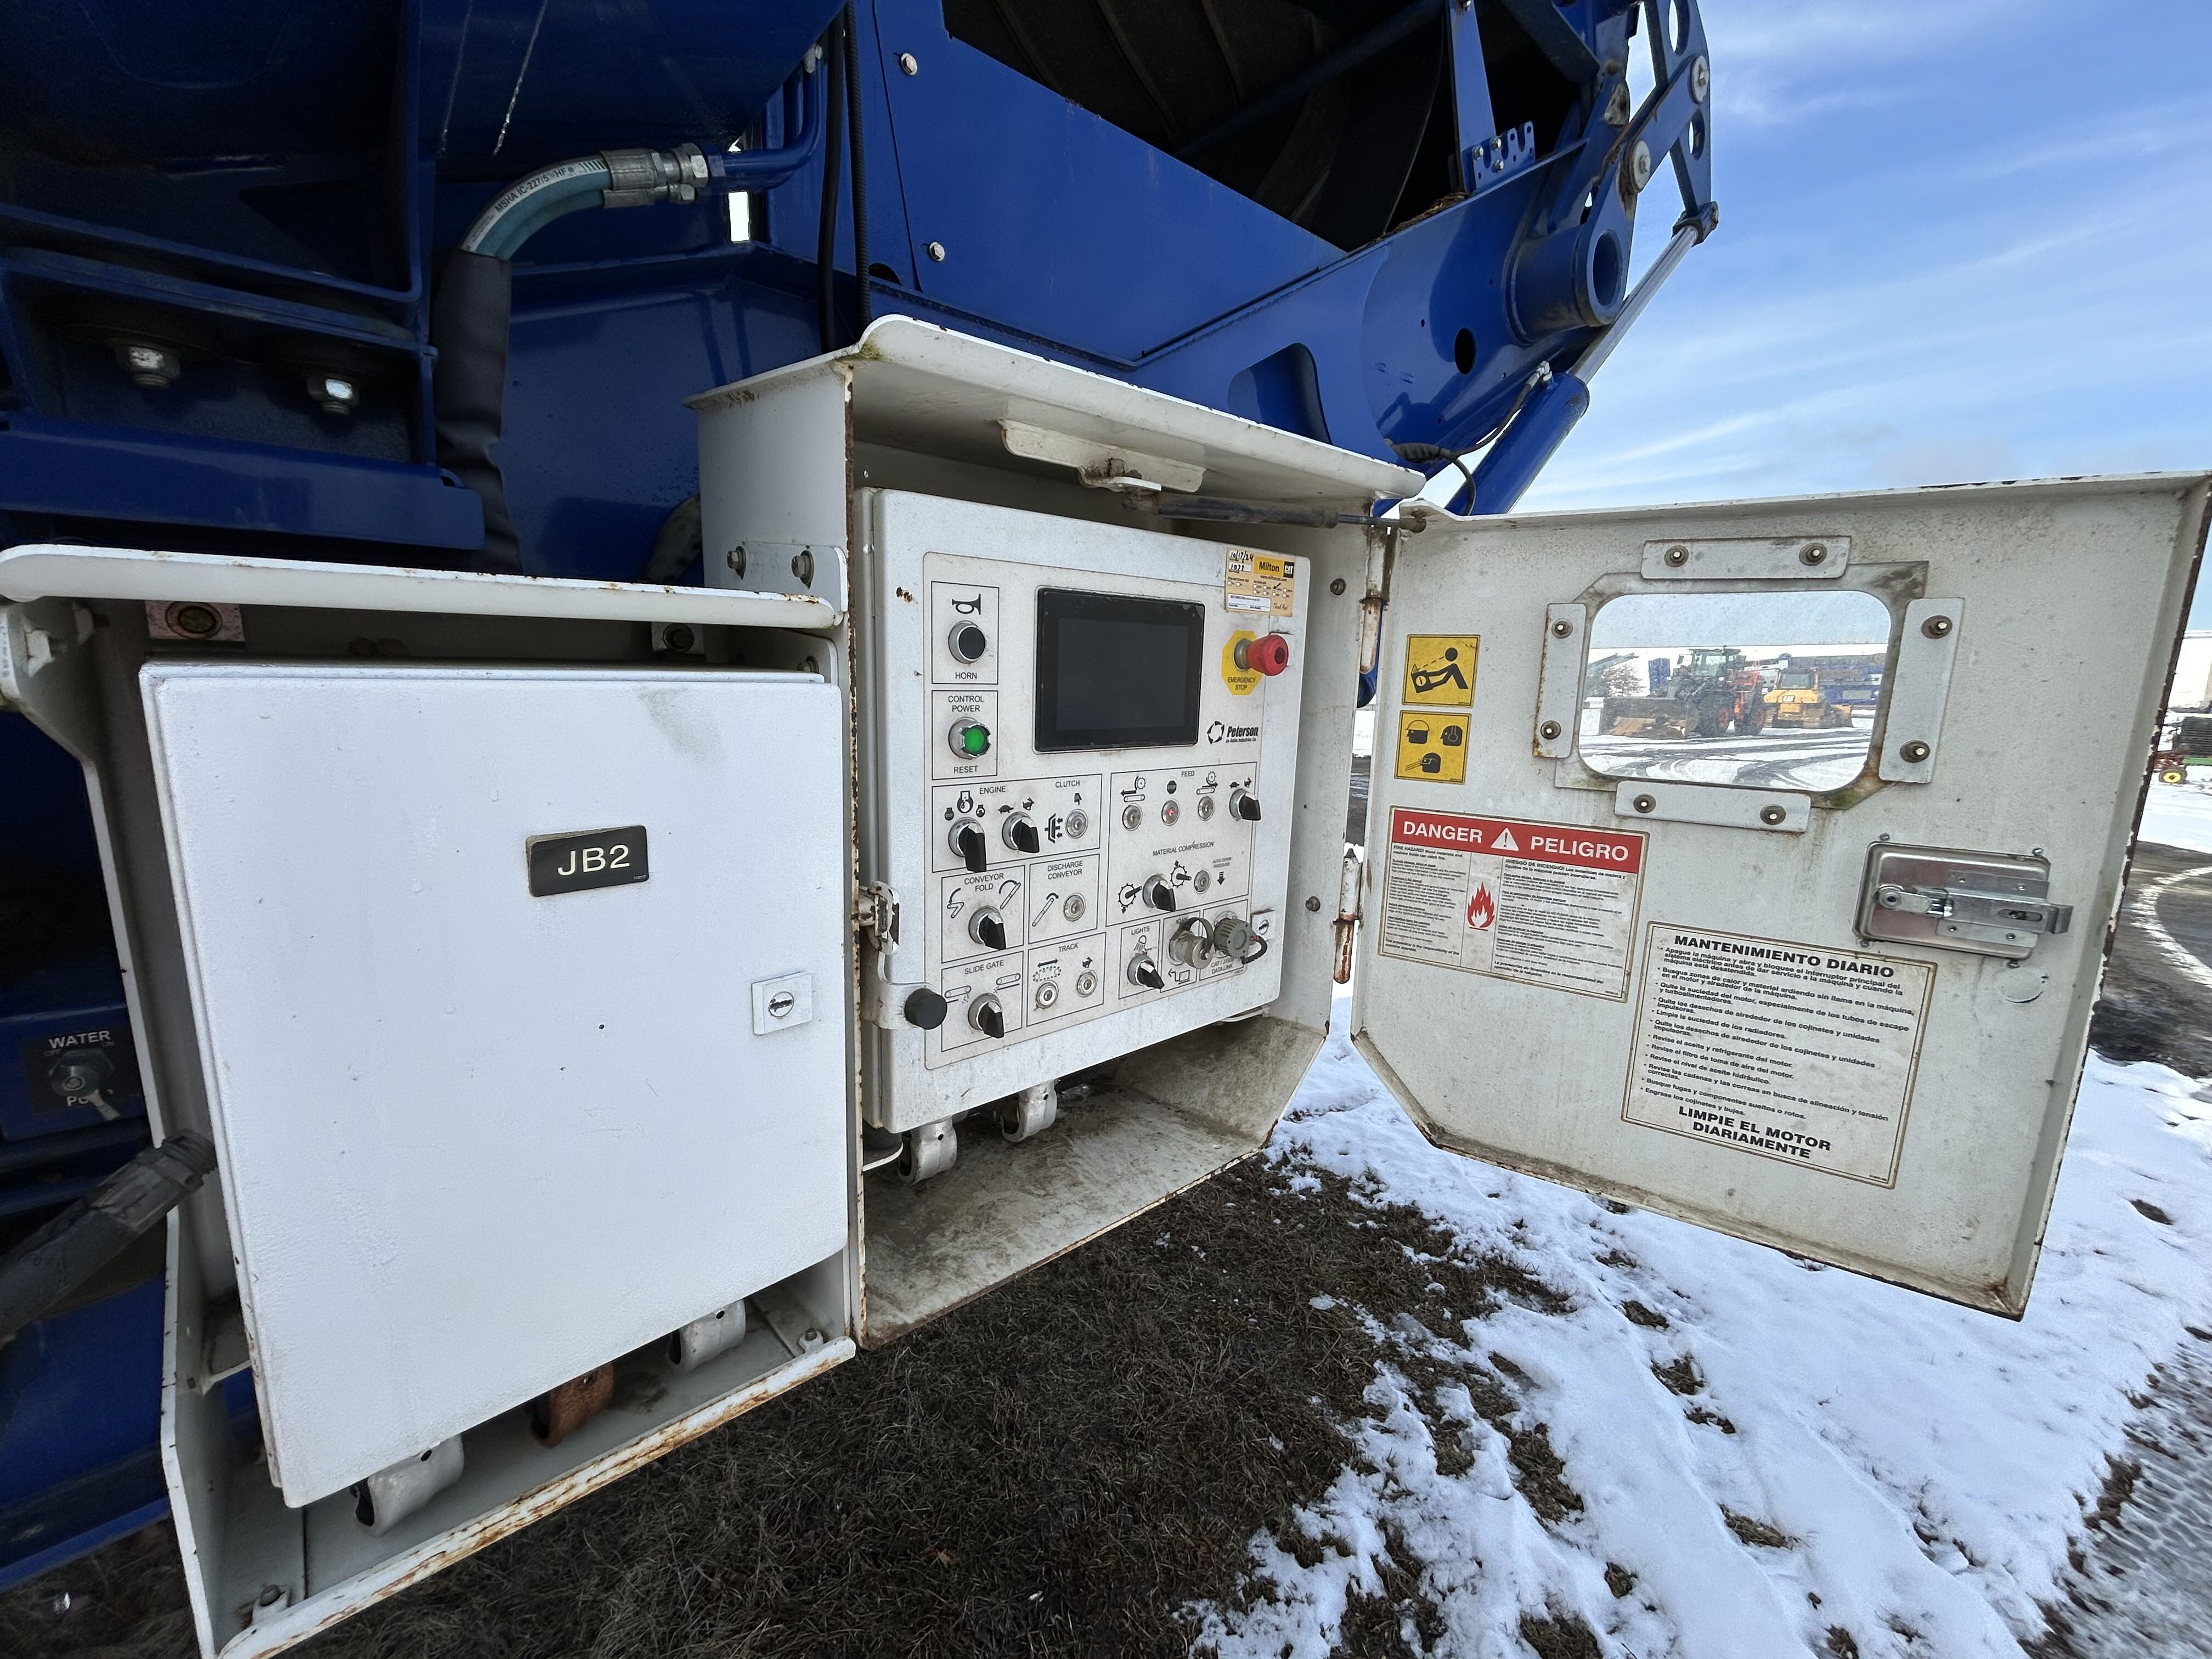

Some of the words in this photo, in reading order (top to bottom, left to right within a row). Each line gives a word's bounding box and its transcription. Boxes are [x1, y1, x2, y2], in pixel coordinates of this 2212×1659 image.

[495, 193, 518, 213] MSHA
[554, 168, 567, 177] HF
[1259, 561, 1279, 572] Milton
[1284, 565, 1293, 574] CAT
[1226, 726, 1259, 737] Peterson
[953, 765, 978, 774] RESET
[979, 786, 1006, 794] ENGINE
[1055, 780, 1080, 788] CLUTCH
[1152, 847, 1177, 856] MATERIAL
[1178, 841, 1214, 853] COMPRESSION
[1403, 821, 1483, 844] DANGER
[1531, 836, 1629, 861] PELIGRO
[557, 845, 630, 876] JB2
[1047, 860, 1083, 872] DISCHARGE
[964, 872, 1004, 885] CONVEYOR
[1048, 868, 1082, 880] CONVEYOR
[975, 883, 994, 892] FOLD
[1131, 926, 1150, 935] LIGHTS
[1058, 943, 1079, 952] TRACK
[1673, 935, 1821, 967] MANTENIMIENTO
[1826, 958, 1894, 978] DIARIO
[964, 965, 984, 975] SLIDE
[986, 960, 1004, 969] GATE
[1211, 966, 1221, 974] DATA
[1663, 957, 1692, 967] máquina
[1710, 964, 1757, 977] desatendida.
[1664, 946, 1691, 956] Apague
[1700, 952, 1731, 963] máquina
[1763, 962, 1795, 973] bloquee
[1804, 969, 1848, 981] interruptor
[1849, 976, 1885, 988] principal
[1664, 951, 1691, 960] sistema
[1691, 956, 1723, 966] eléctrico
[1770, 969, 1801, 979] servicio
[1819, 977, 1854, 988] máquina
[1862, 984, 1893, 994] cuando
[1662, 967, 1688, 977] Busque
[1748, 981, 1779, 991] material
[1780, 987, 1815, 997] ardiendo
[1831, 995, 1853, 1004] llama
[1876, 1003, 1915, 1015] máquina,
[1664, 988, 1734, 1005] turboalimentadores.
[1657, 1002, 1696, 1014] impulsoras.
[1687, 986, 1719, 996] suciedad
[1733, 995, 1757, 1005] motor,
[1758, 999, 1814, 1015] especialmente
[1842, 1014, 1865, 1023] tubos
[1878, 1022, 1909, 1032] escape
[1656, 1009, 1678, 1019] Limpie
[1687, 1015, 1719, 1026] suciedad
[1744, 1026, 1787, 1039] radiadores.
[1689, 1002, 1723, 1013] desechos
[1735, 1011, 1771, 1023] alrededor
[1798, 1023, 1834, 1035] cojinetes
[1842, 1031, 1880, 1043] unidades
[49, 1031, 111, 1048] WATER
[1652, 1034, 1675, 1043] Revise
[1684, 1041, 1705, 1049] aceite
[1712, 1046, 1754, 1060] refrigerante
[1769, 1058, 1793, 1068] motor.
[1646, 1078, 1671, 1089] Busque
[1672, 1084, 1691, 1093] fugas
[1699, 1090, 1747, 1106] componentes
[1748, 1102, 1775, 1112] sueltos
[1784, 1110, 1807, 1119] rotos.
[1678, 1105, 1735, 1127] LIMPIE
[1739, 1120, 1761, 1133] EL
[1765, 1126, 1831, 1151] MOTOR
[1692, 1121, 1811, 1158] DIARIAMENTE
